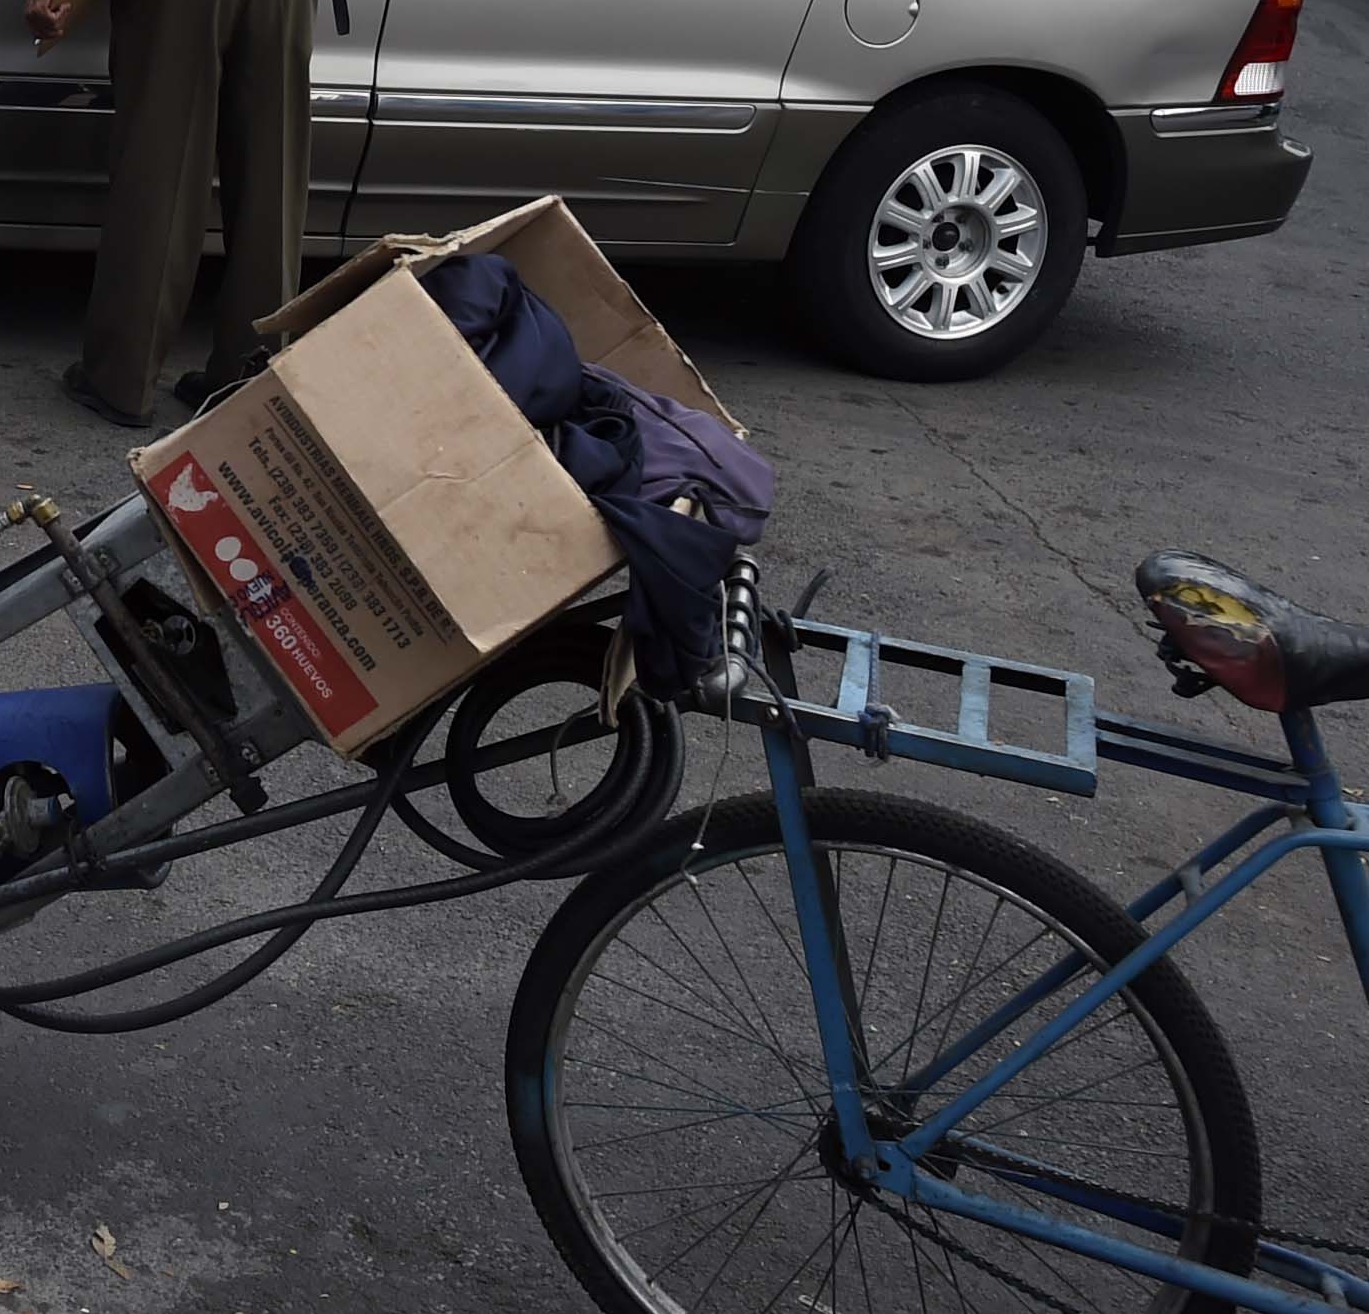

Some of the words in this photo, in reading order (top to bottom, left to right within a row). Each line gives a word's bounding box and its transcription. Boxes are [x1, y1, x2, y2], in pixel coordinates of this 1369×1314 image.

[246, 436, 276, 469] Tels.
[291, 495, 316, 523] 383
[380, 614, 413, 651] 1713
[267, 494, 295, 525] Fax:
[309, 551, 335, 580] 383
[264, 612, 299, 652] 360
[290, 646, 335, 701] HUEVOS
